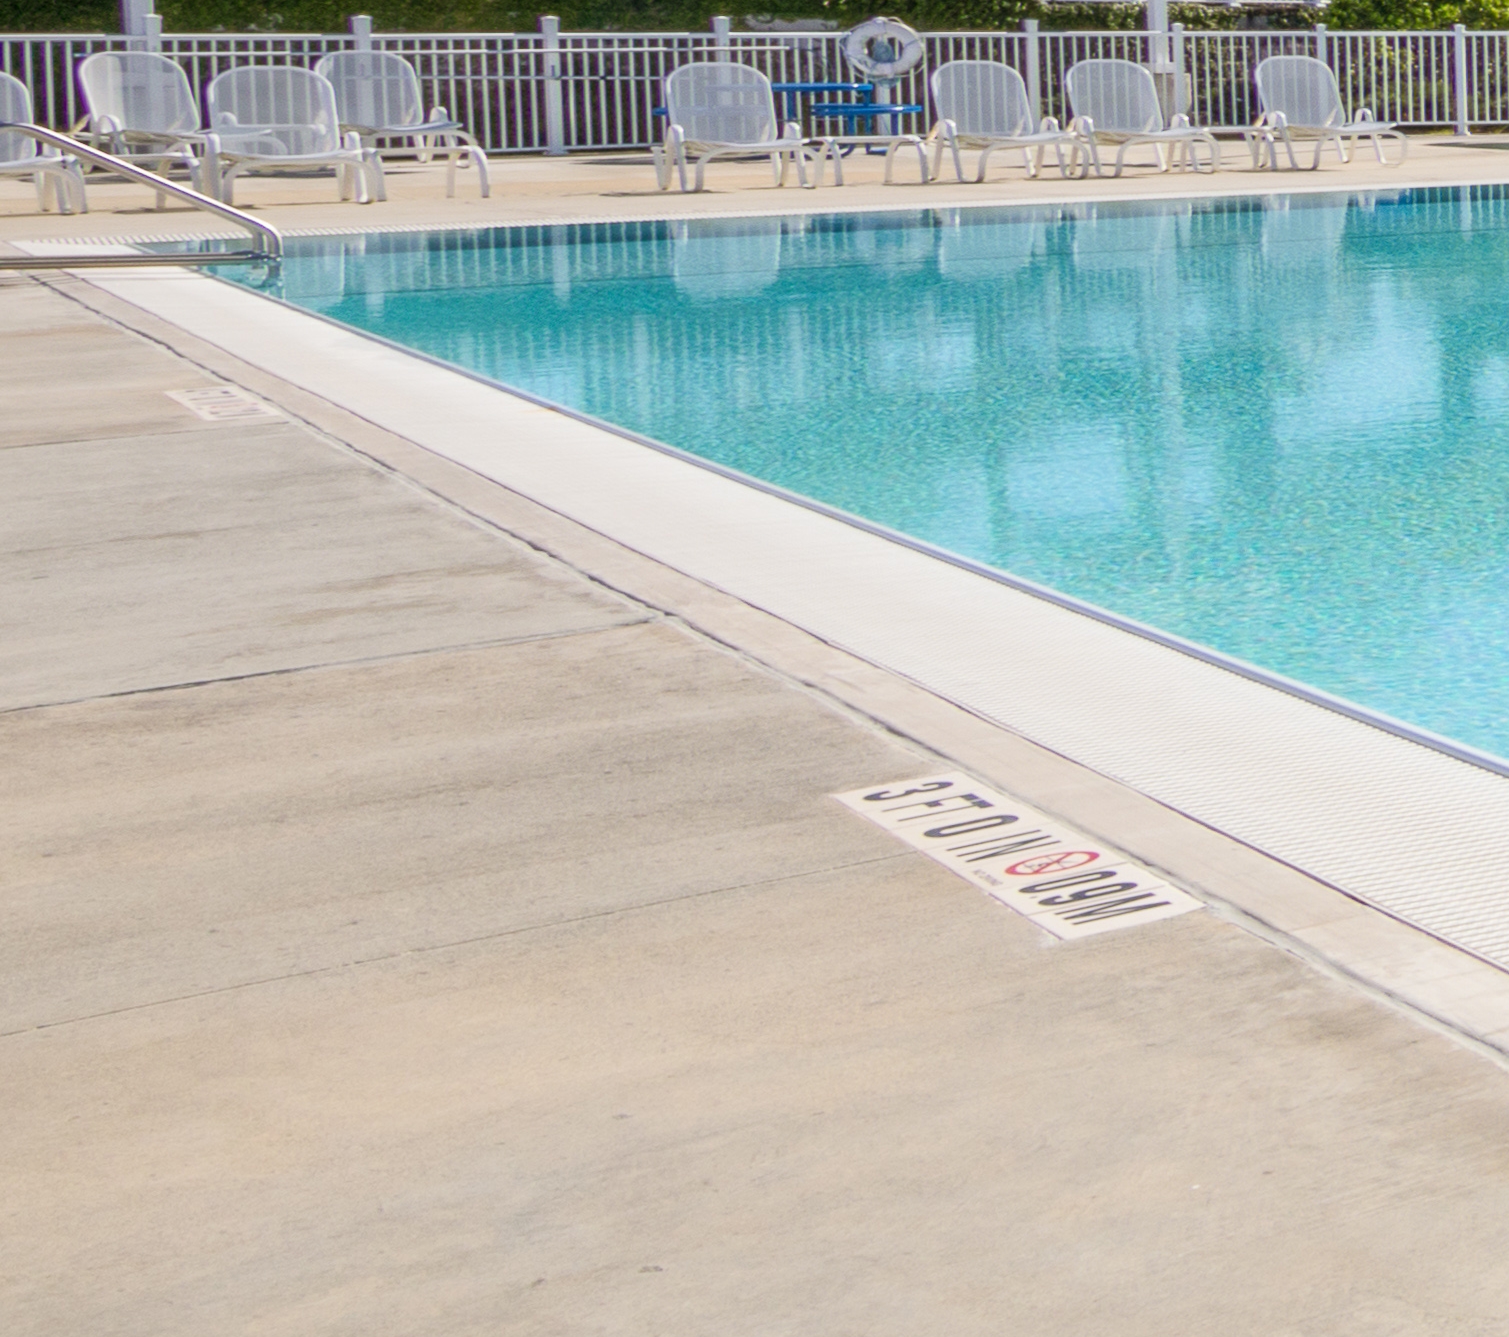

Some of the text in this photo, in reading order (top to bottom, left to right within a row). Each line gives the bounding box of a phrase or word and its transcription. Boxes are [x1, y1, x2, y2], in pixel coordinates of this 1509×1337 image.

[862, 780, 954, 802] 3
[881, 792, 995, 823] FT
[946, 828, 1062, 864] IN
